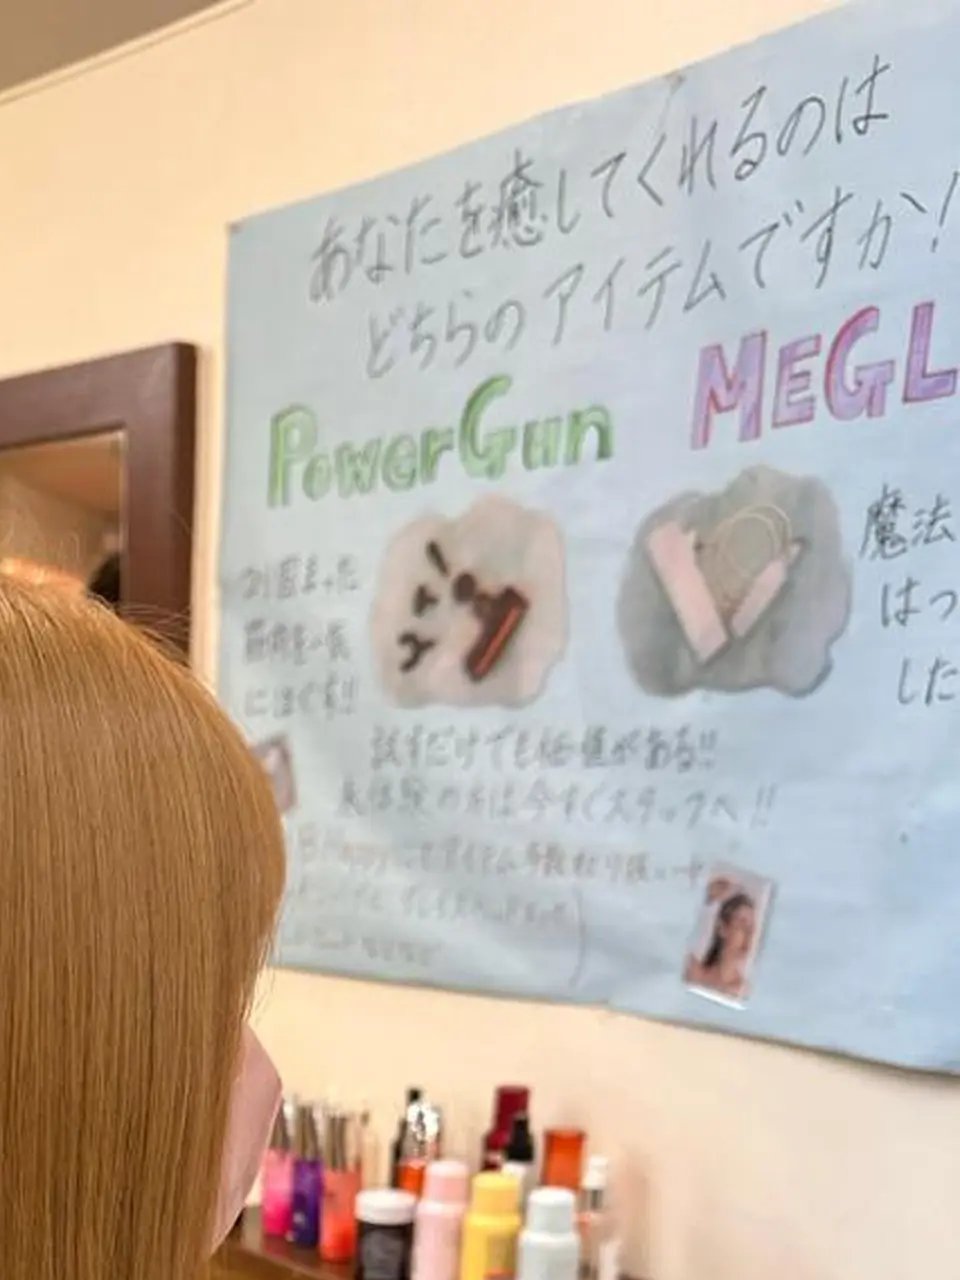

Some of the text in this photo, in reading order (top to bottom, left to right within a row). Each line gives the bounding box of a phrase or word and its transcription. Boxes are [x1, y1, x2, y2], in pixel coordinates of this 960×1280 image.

[309, 53, 892, 304] あなたを癒してくれるのは
[266, 373, 615, 508] PowerGun
